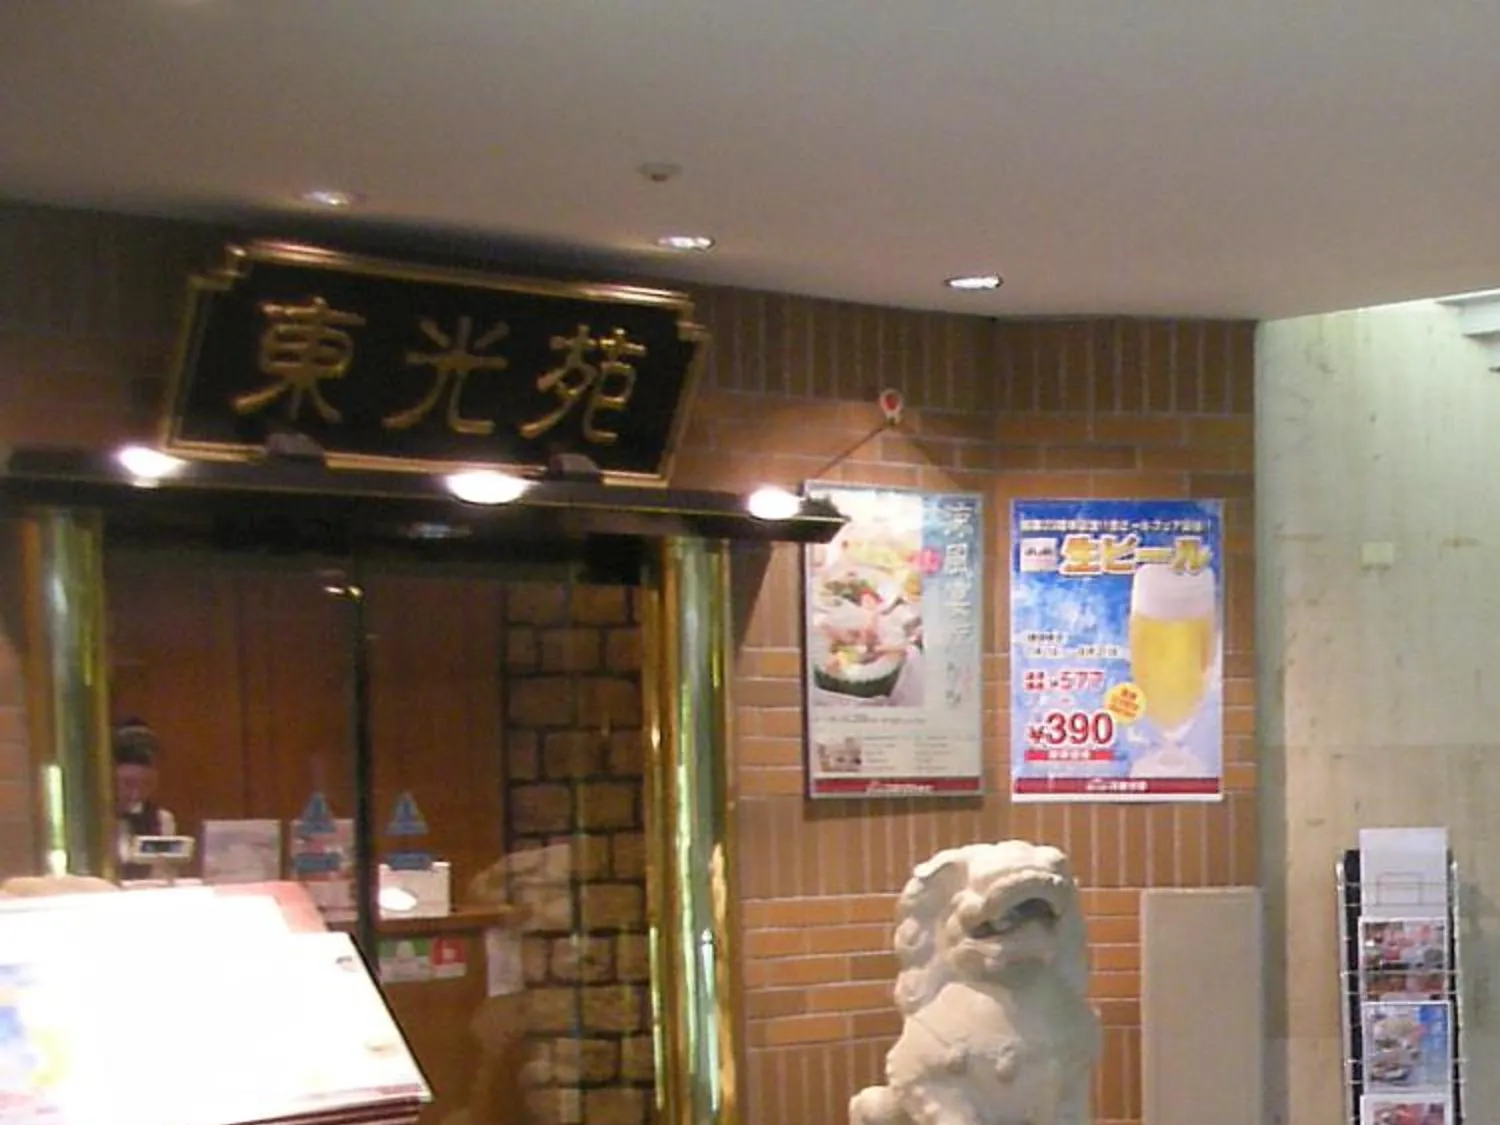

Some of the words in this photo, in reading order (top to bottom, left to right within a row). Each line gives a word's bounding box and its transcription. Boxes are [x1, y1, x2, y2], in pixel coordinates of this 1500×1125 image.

[231, 297, 647, 443] 東光苑
[1059, 533, 1213, 577] 生ビール
